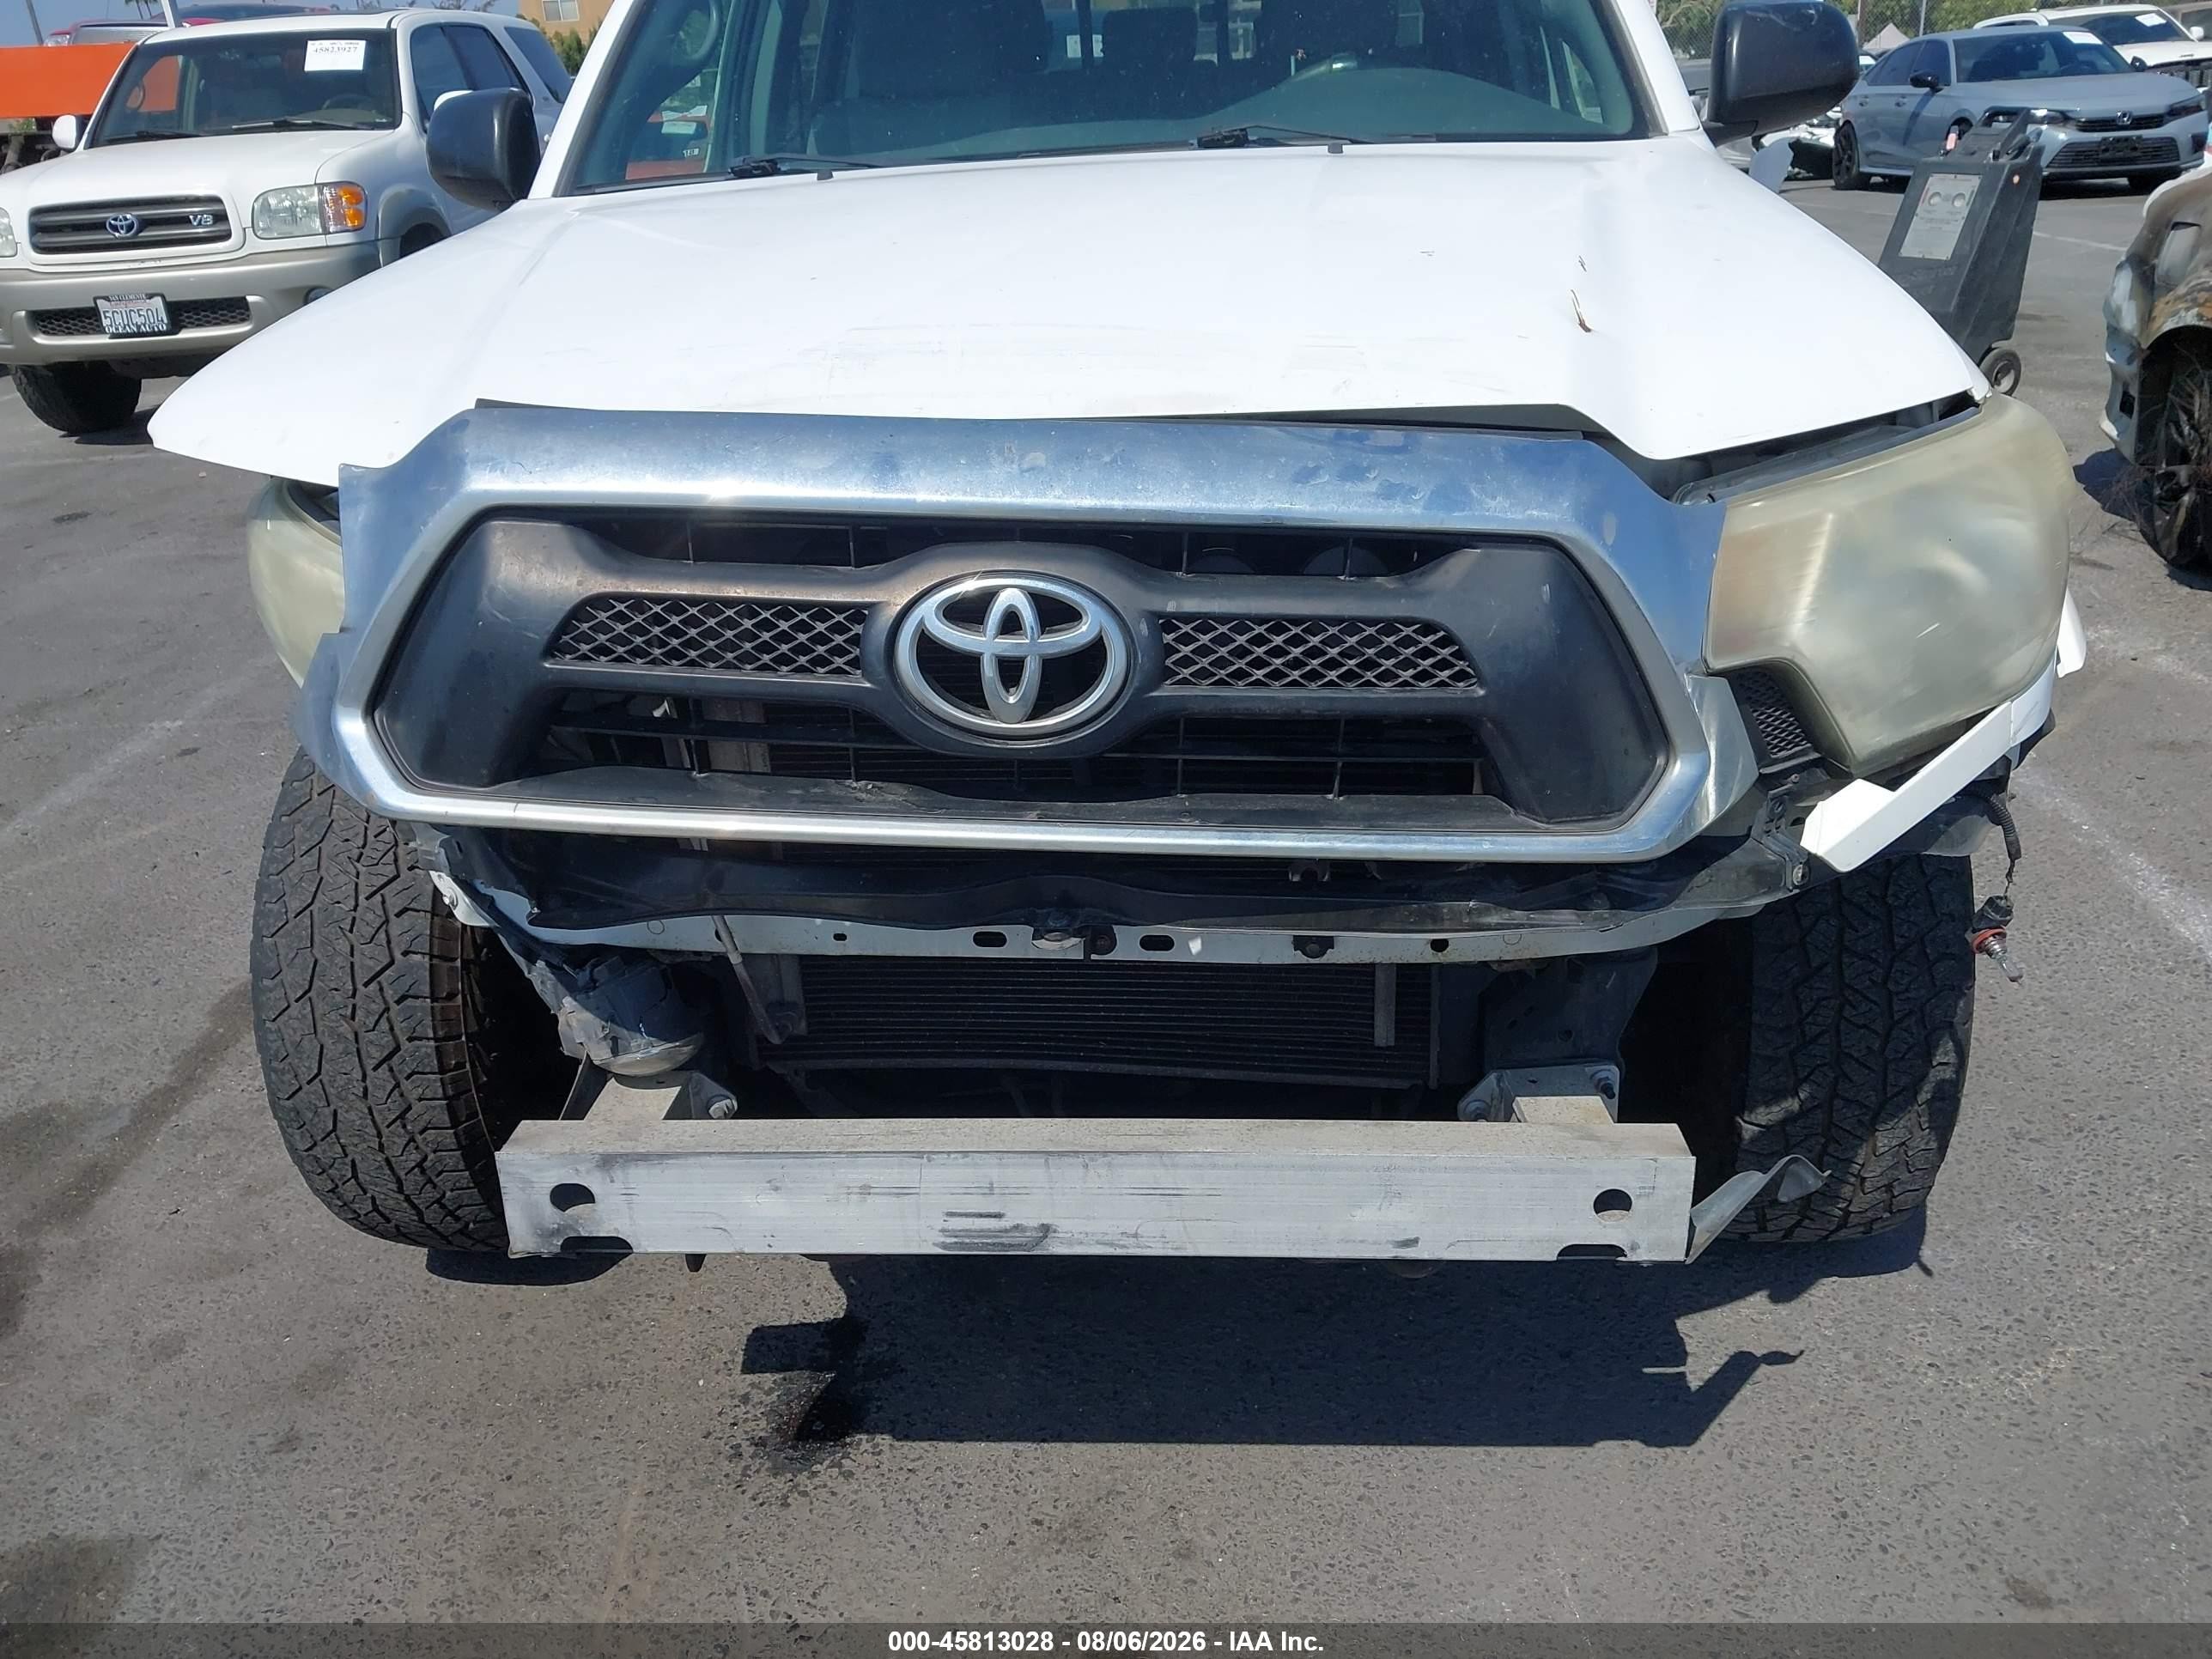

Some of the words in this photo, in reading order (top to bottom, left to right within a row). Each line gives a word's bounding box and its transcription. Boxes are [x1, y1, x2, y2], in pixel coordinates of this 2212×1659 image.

[189, 215, 214, 225] V8
[102, 308, 165, 326] 5CUC504
[139, 324, 167, 332] AUTO
